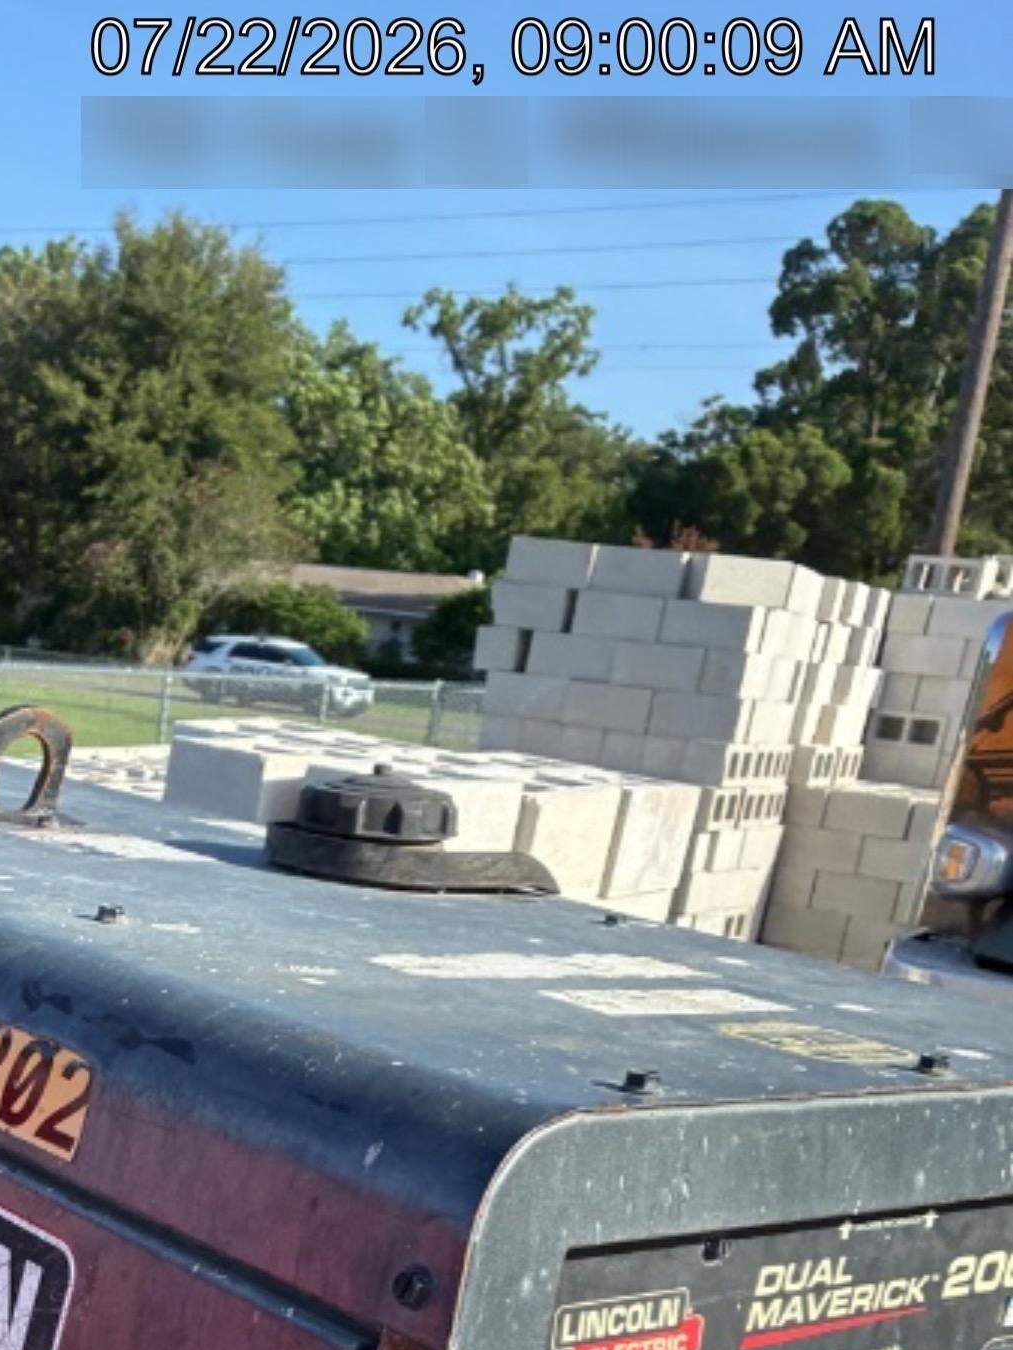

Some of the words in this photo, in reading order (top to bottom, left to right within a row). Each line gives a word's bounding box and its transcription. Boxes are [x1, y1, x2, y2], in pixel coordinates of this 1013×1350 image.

[754, 1256, 854, 1299] DUAL
[560, 1296, 683, 1343] LINCOLN
[745, 1275, 929, 1333] MAVERICK
